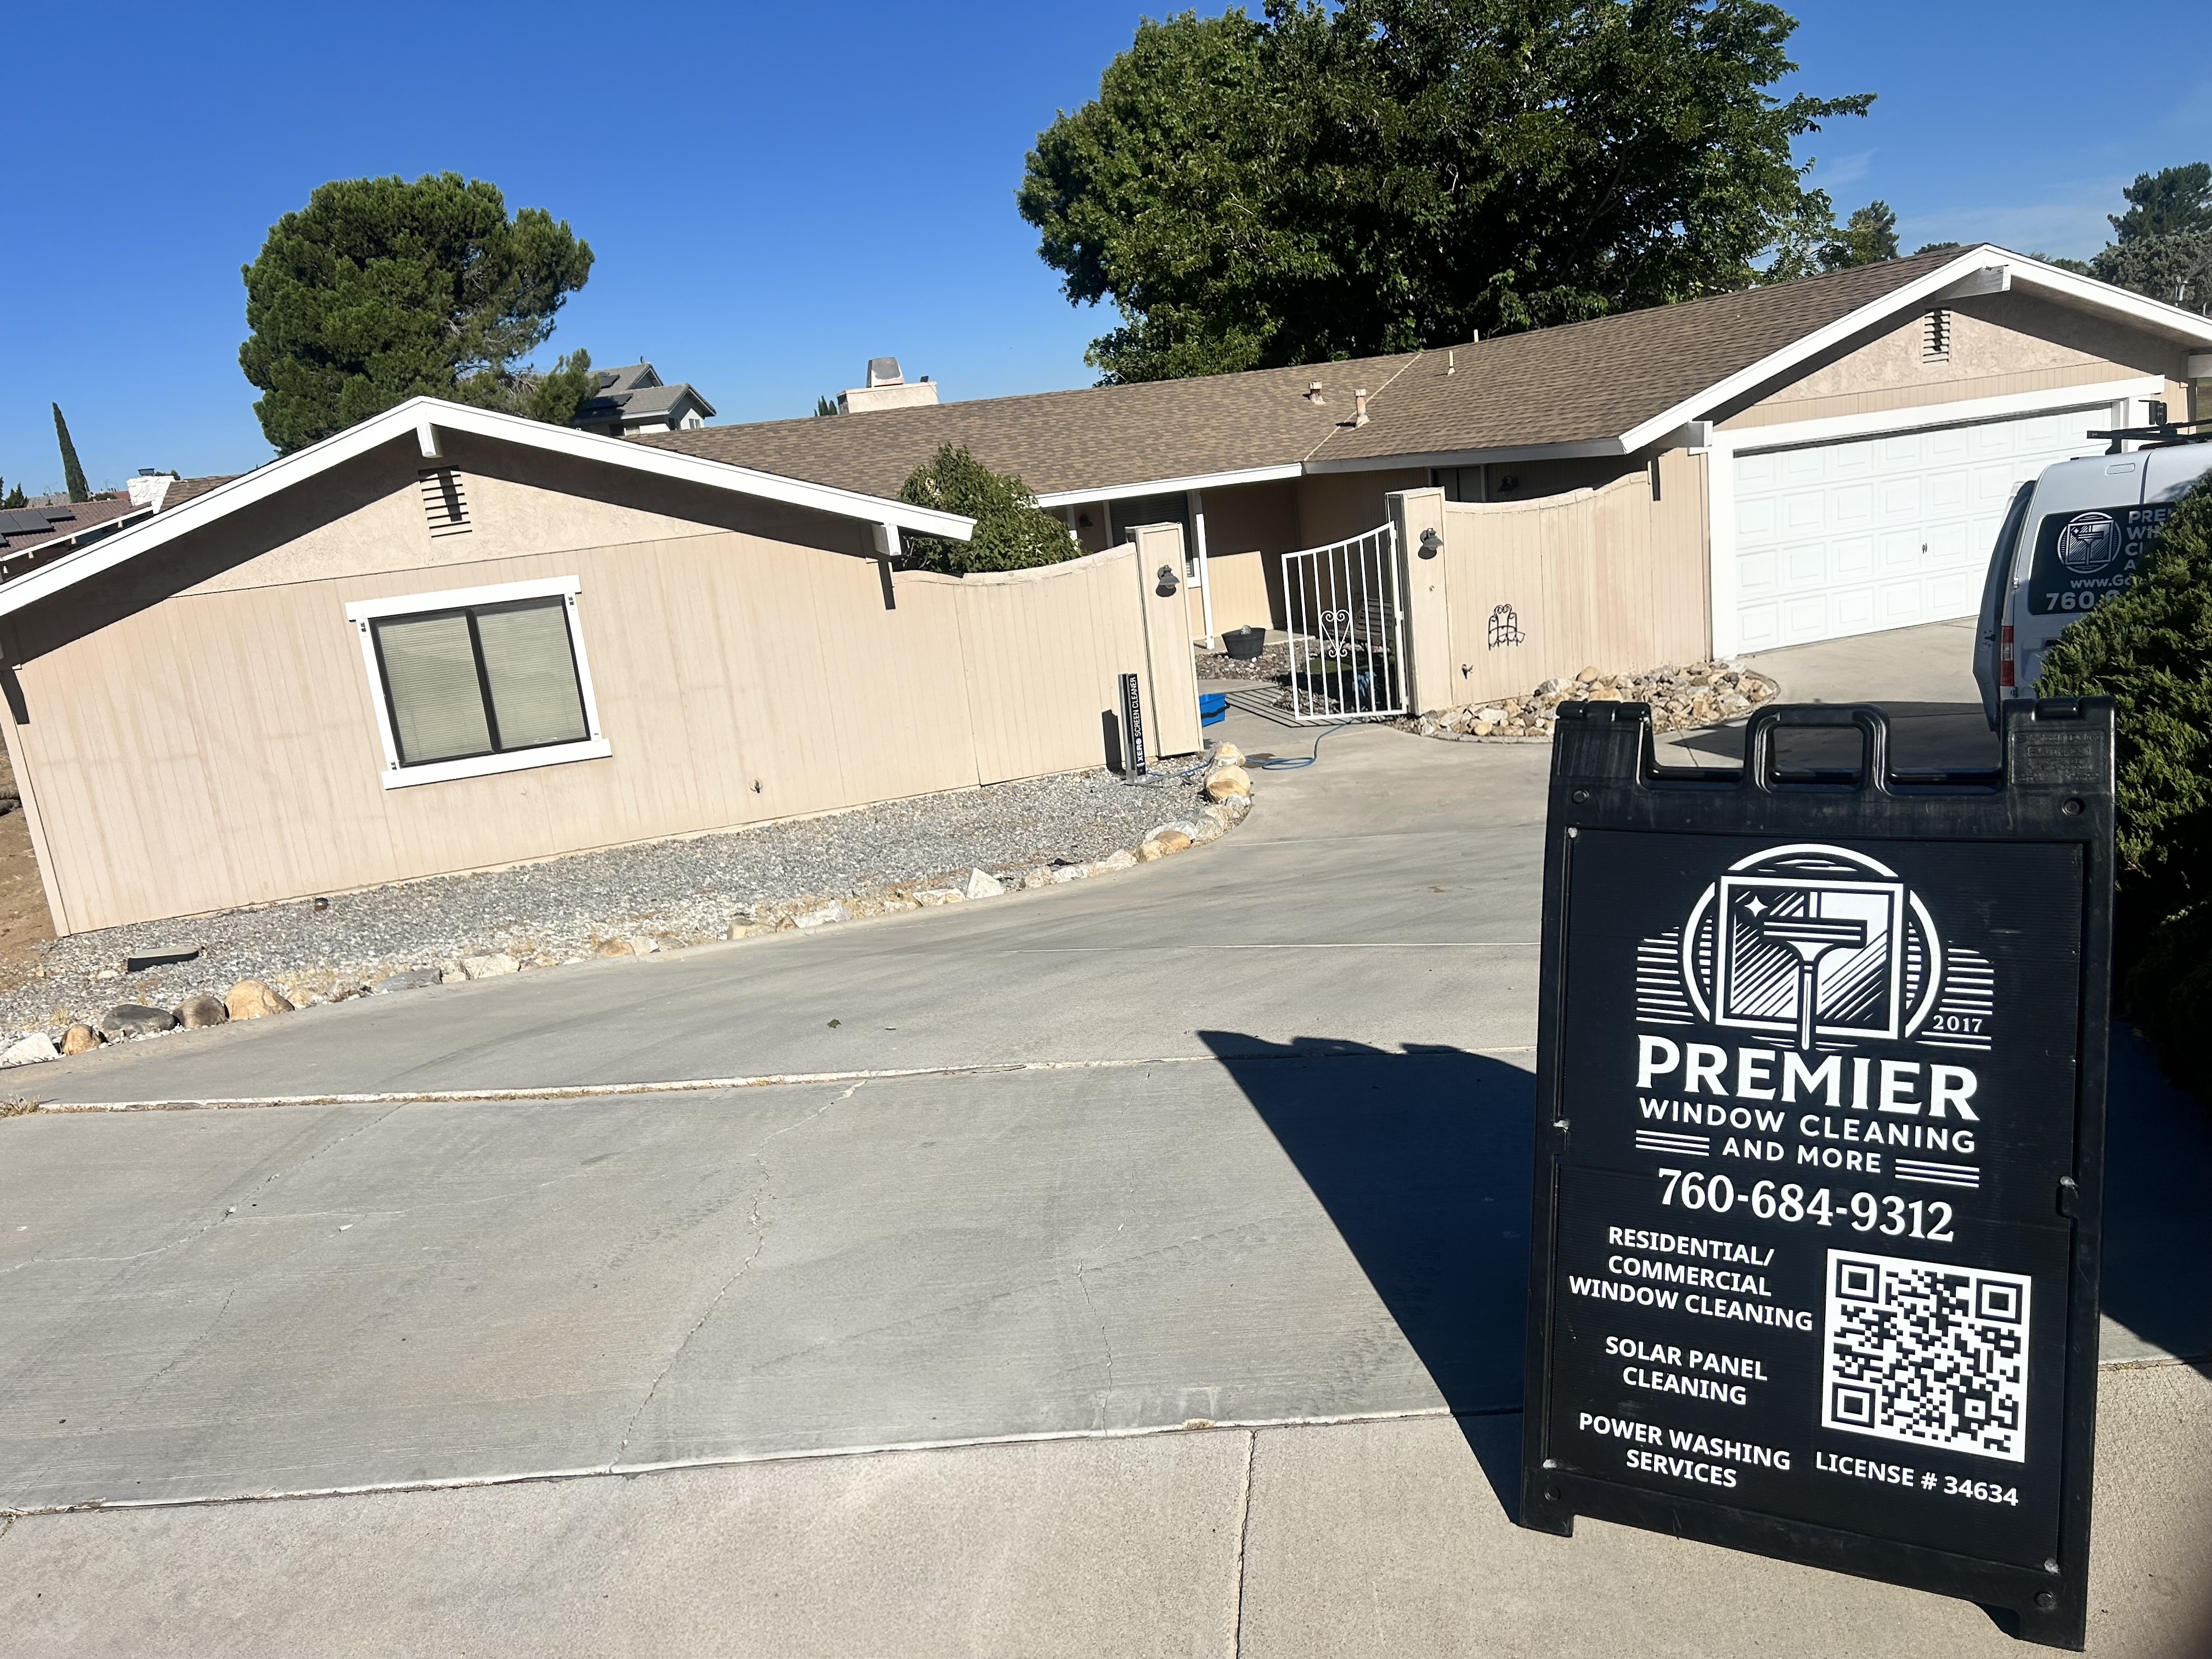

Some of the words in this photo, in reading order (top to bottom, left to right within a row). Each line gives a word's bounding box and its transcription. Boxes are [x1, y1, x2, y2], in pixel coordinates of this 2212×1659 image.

[2129, 508, 2171, 524] PRE
[1130, 677, 1139, 708] CLEANER
[1132, 710, 1141, 737] SCREEN
[1933, 1015, 1983, 1032] 2017
[1635, 1034, 1980, 1120] PREMIER
[1639, 1097, 1785, 1132] WINDOW
[1799, 1115, 1975, 1153] CLEANING
[1723, 1137, 1785, 1161] AND
[1798, 1145, 1881, 1173] MORE
[1658, 1168, 1954, 1242] 760-684-9312
[1610, 1227, 1775, 1266] RESIDENTIAL/
[1609, 1256, 1771, 1297] COMMERCIAL
[1570, 1276, 1679, 1310] WINDOW
[1685, 1295, 1813, 1331] CLEANING
[1606, 1336, 1683, 1366] SOLAR
[1690, 1350, 1768, 1381] PANEL
[1623, 1367, 1746, 1405] CLEANING
[1580, 1413, 1663, 1446] POWER
[1669, 1430, 1790, 1470] WASHING
[1627, 1449, 1737, 1488] SERVICES
[1816, 1452, 1914, 1487] LICENSE
[1921, 1472, 1938, 1490] #
[1944, 1476, 2019, 1506] 34634
